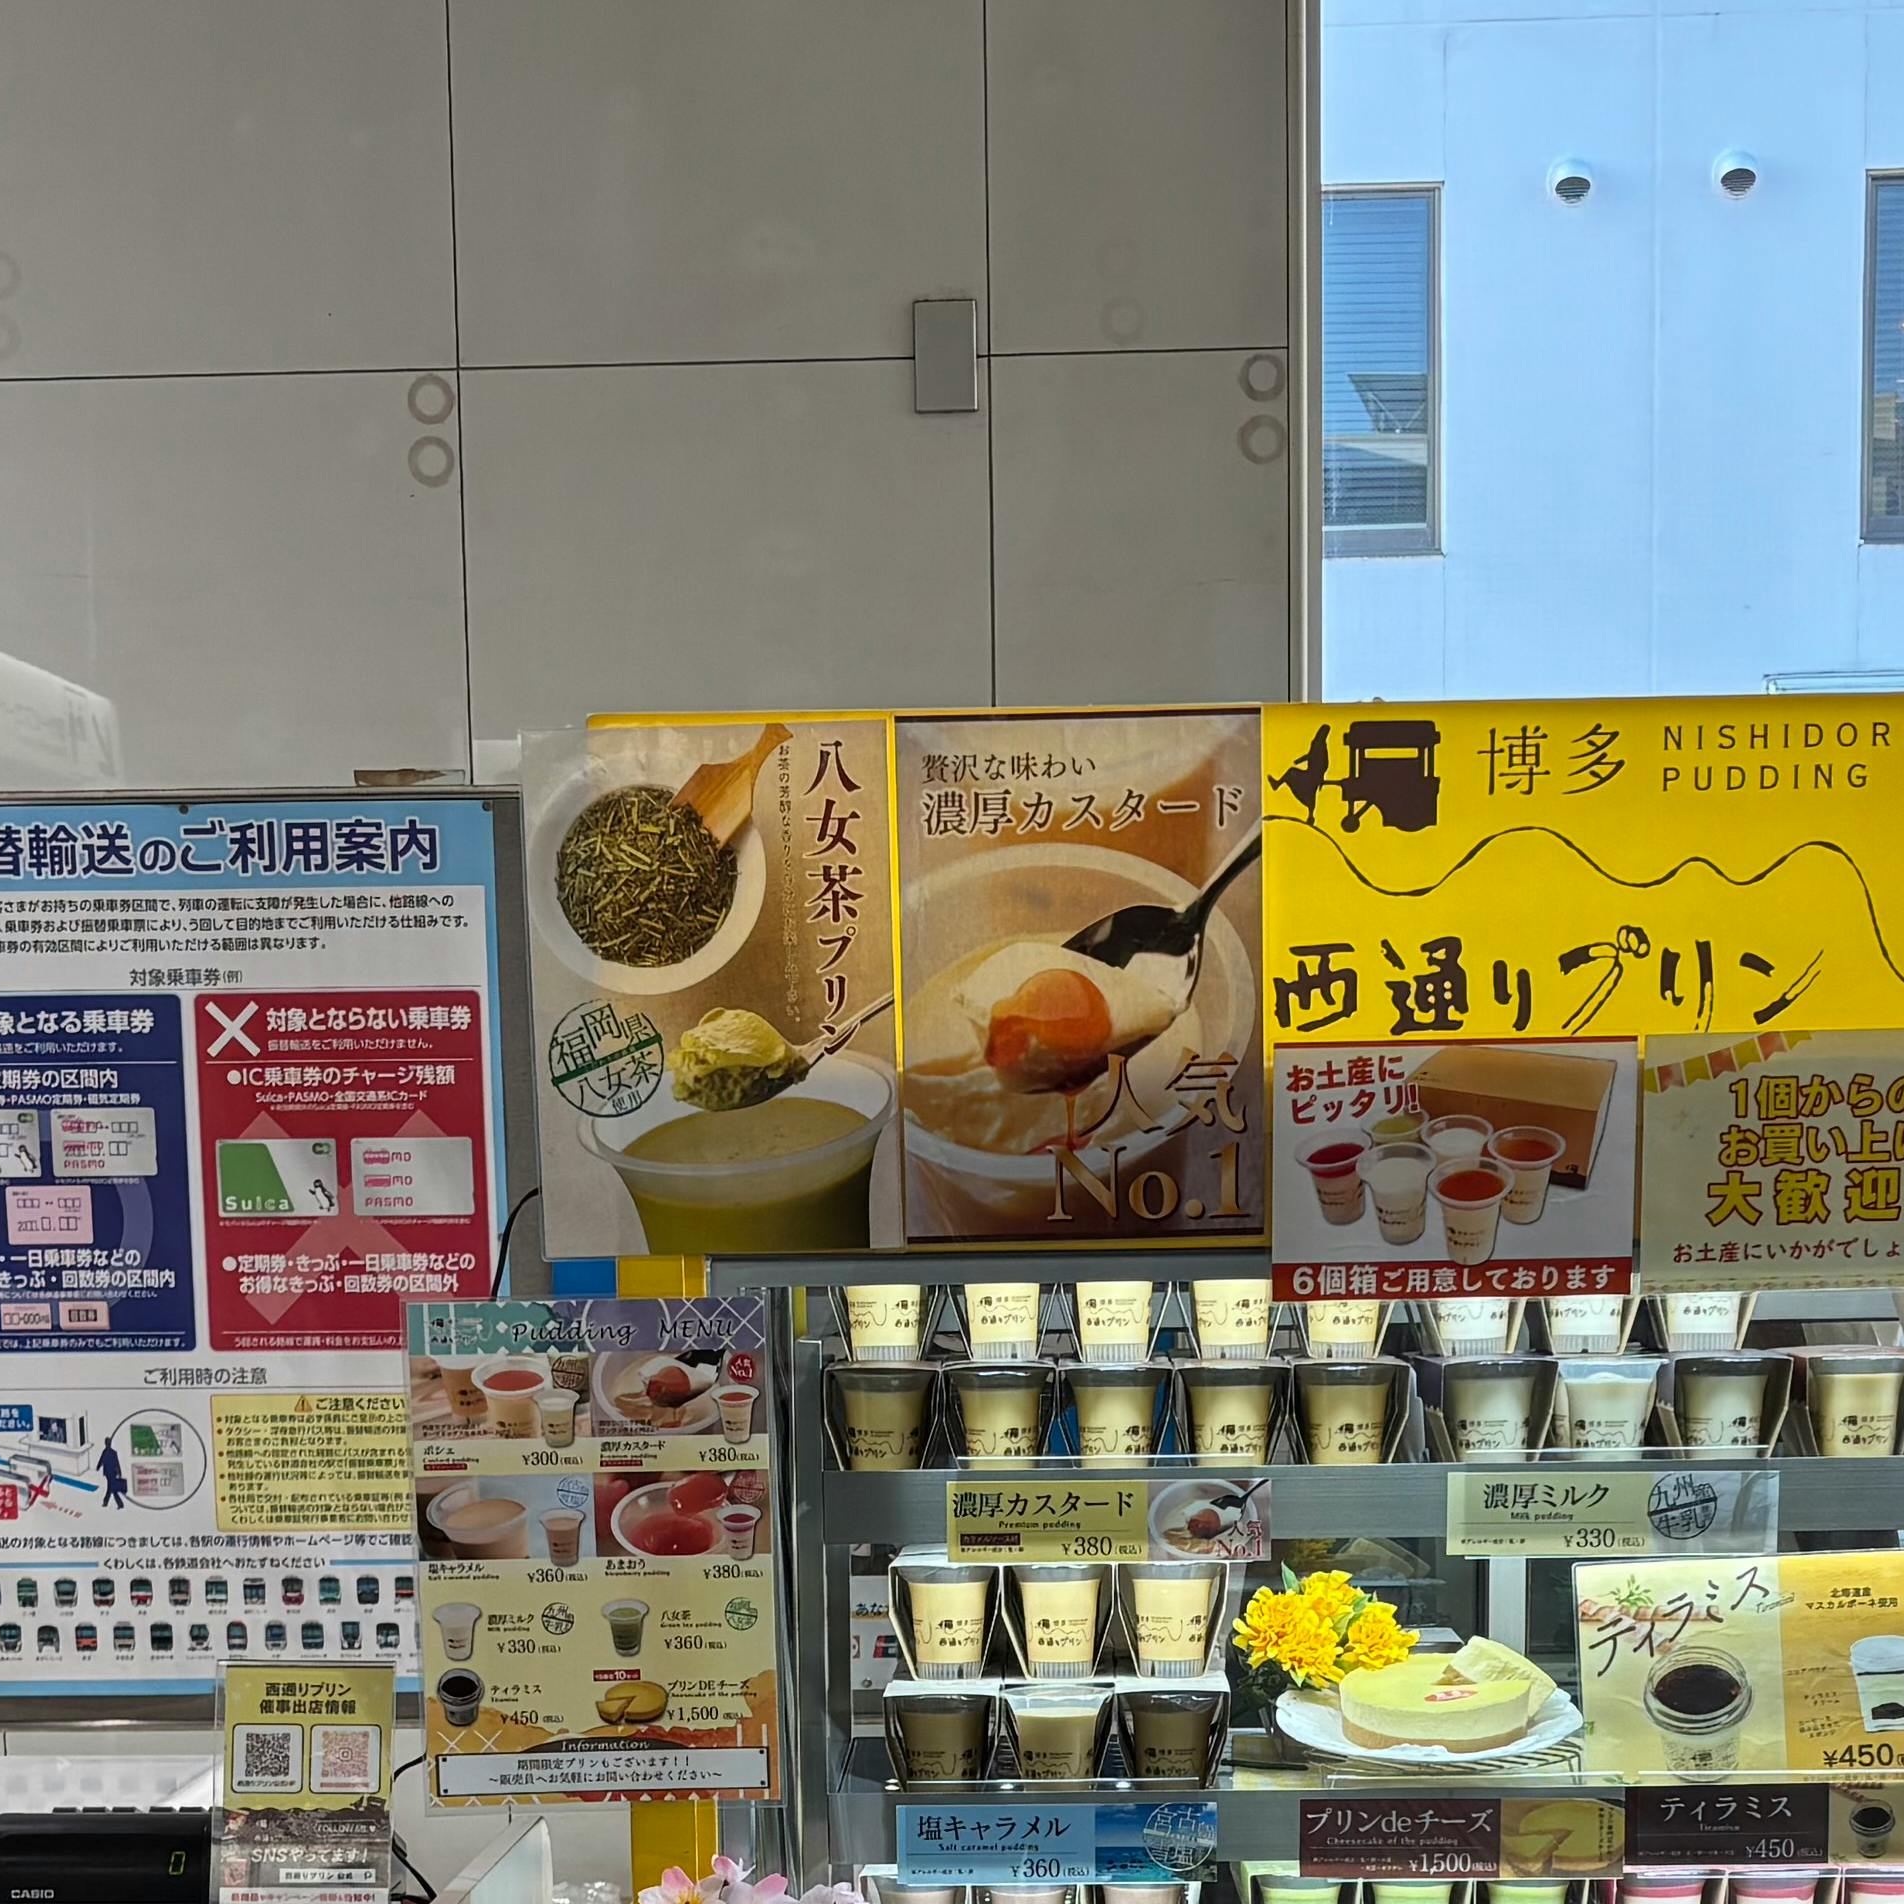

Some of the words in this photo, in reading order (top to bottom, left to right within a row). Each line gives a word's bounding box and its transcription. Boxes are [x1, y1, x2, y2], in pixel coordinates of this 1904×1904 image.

[921, 751, 1098, 783] 贅沢な味わい
[1476, 721, 1626, 797] 博多
[1661, 762, 1871, 793] PUDDING
[922, 784, 1245, 838] 濃厚カスタード
[802, 737, 868, 1060] 八女茶プリン
[1272, 924, 1825, 1036] 西通りプリン
[266, 1005, 473, 1034] 対象とならない乗車券
[1285, 1054, 1407, 1095] お土産に
[1085, 1050, 1249, 1136] 人気
[1046, 1144, 1254, 1224] No.1
[221, 1194, 292, 1212] Suica
[1291, 1263, 1616, 1295] 6個箱ご用意しております
[511, 1319, 635, 1345] Pudding
[143, 1365, 269, 1386] ご利用時の注意
[951, 1490, 1135, 1520] 濃厚カスタード
[1482, 1480, 1611, 1511] 濃厚ミルク
[264, 1682, 352, 1698] 西通りプリン
[259, 1699, 357, 1715] 催事出店情報
[1305, 1804, 1495, 1836] プリンdeチーズ
[1658, 1792, 1794, 1823] ティラミス
[917, 1813, 1072, 1843] 塩キャラメル
[10, 1888, 56, 1900] CASIO
